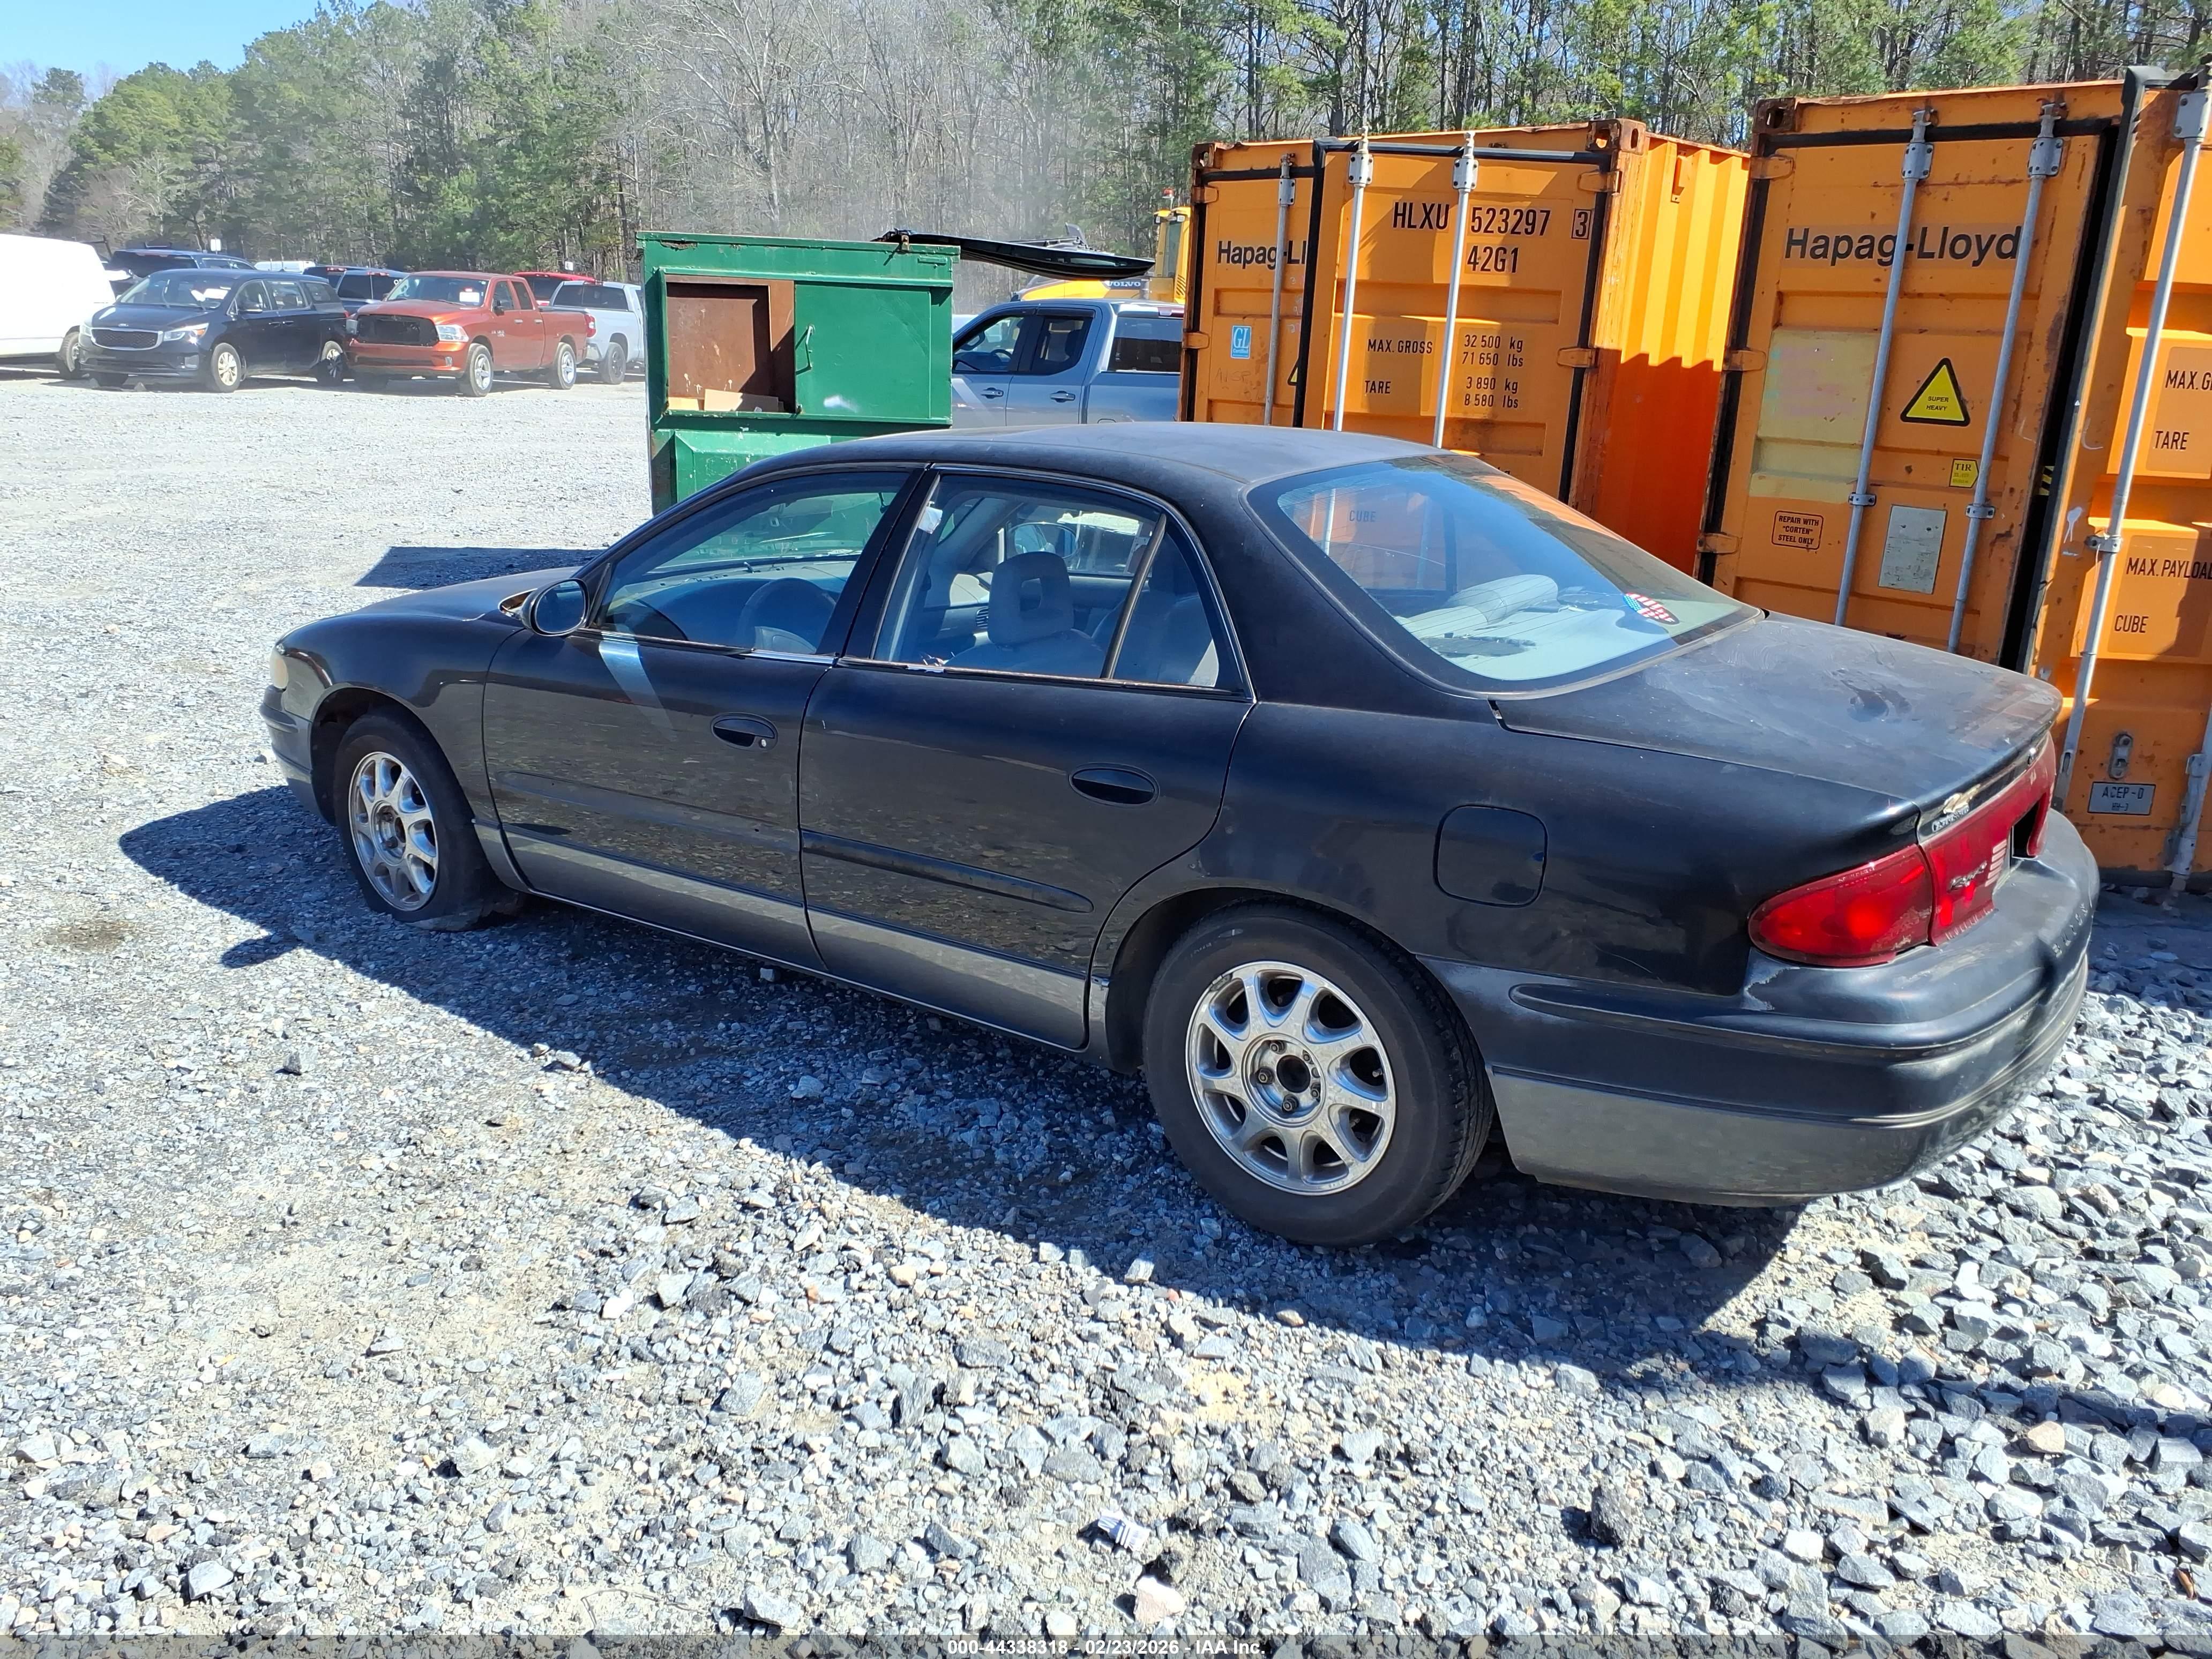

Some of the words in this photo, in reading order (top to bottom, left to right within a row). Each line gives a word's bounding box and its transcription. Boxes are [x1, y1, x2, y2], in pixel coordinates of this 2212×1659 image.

[1393, 201, 1449, 230] HLXU
[1470, 207, 1551, 236] 523297
[1784, 226, 2022, 266] Hapag-Lloyd
[1467, 245, 1519, 274] 42G1
[1233, 327, 1250, 348] GL
[1367, 339, 1394, 353] MAX.
[1398, 340, 1433, 354] GROSS
[1464, 334, 1477, 348] 32
[1481, 335, 1501, 349] 500
[1509, 336, 1523, 353] kg
[1462, 351, 1475, 365] 71
[1478, 353, 1499, 366] 650
[1507, 353, 1523, 367] lbs
[1364, 380, 1392, 394] TARE
[1466, 376, 1473, 389] 3
[1476, 377, 1496, 390] 890
[1504, 378, 1518, 394] kg
[2165, 370, 2199, 390] MAX.
[2201, 372, 2212, 391] G
[1464, 393, 1471, 406] 8
[1474, 394, 1494, 407] 580
[1503, 394, 1519, 408] lbs
[2155, 430, 2189, 450] TARE
[1955, 463, 1972, 472] TIR
[1349, 510, 1376, 523] CUBE
[1778, 515, 1801, 524] REPAIR
[1803, 518, 1819, 526] WITH
[1798, 537, 1814, 545] ONLY
[2126, 557, 2158, 577] MAX.
[2114, 615, 2149, 633] CUBE
